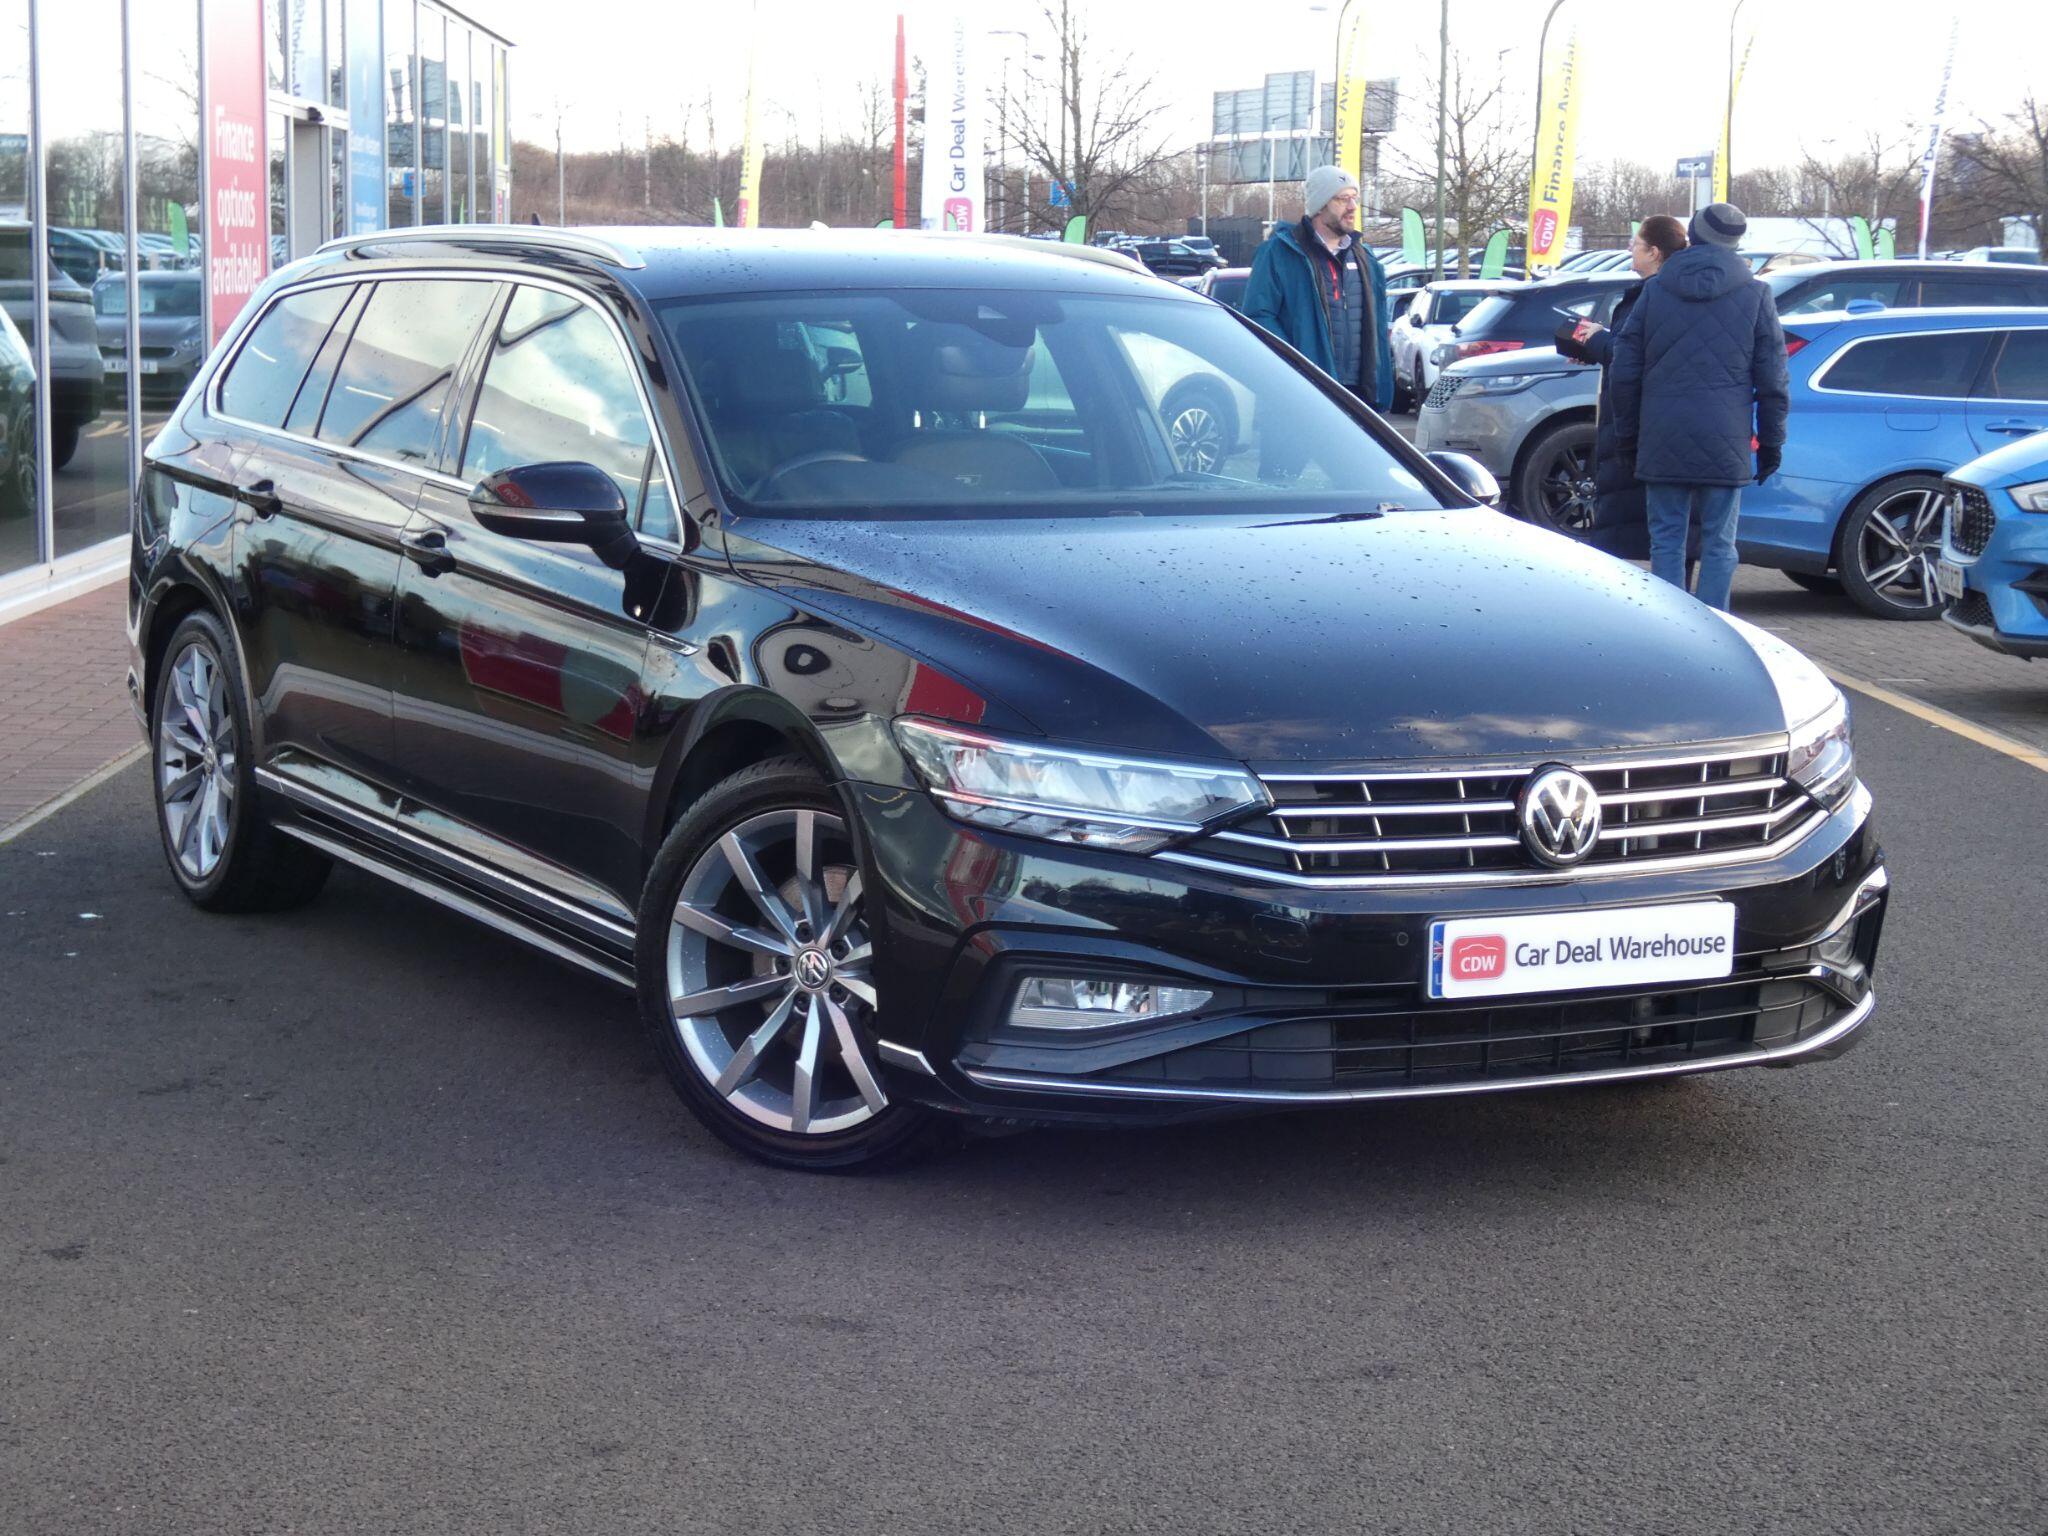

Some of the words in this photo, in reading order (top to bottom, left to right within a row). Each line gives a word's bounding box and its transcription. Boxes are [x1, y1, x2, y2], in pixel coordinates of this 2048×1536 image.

[952, 16, 966, 113] Warehou
[1542, 120, 1567, 204] Finance
[1557, 23, 1578, 113] Availab
[215, 104, 255, 163] Finance
[950, 118, 966, 158] Deal
[950, 164, 966, 192] Car
[1678, 162, 1707, 171] VOO
[217, 175, 256, 243] options
[1540, 217, 1556, 248] CDW
[1460, 955, 1497, 973] CDW
[1515, 942, 1549, 967] Car
[1556, 938, 1602, 964] Deal
[1609, 934, 1726, 961] Warehouse
